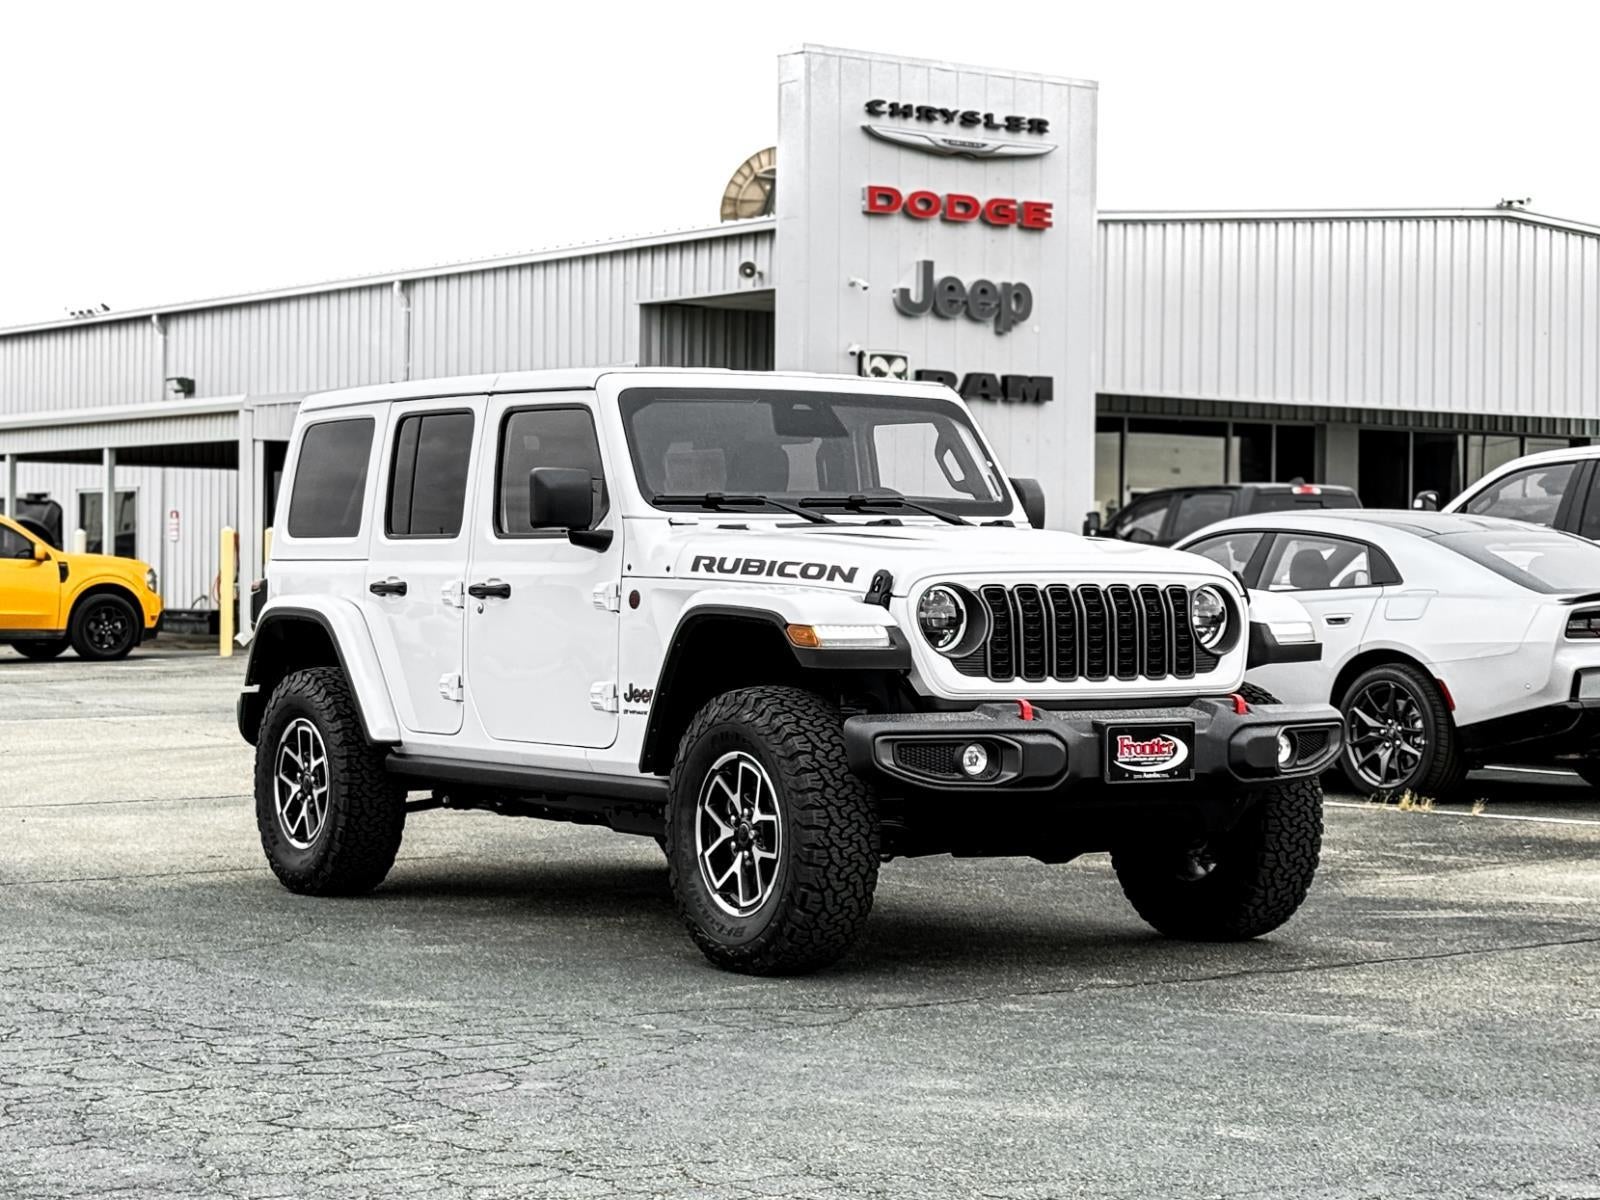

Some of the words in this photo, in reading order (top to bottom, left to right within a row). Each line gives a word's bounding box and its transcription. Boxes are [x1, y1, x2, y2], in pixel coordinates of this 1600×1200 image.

[864, 99, 1050, 134] CHRYSLER
[862, 185, 1053, 229] DODGE
[892, 260, 1033, 335] Jeep
[690, 555, 859, 583] RUBICON
[1117, 735, 1174, 757] Frontier
